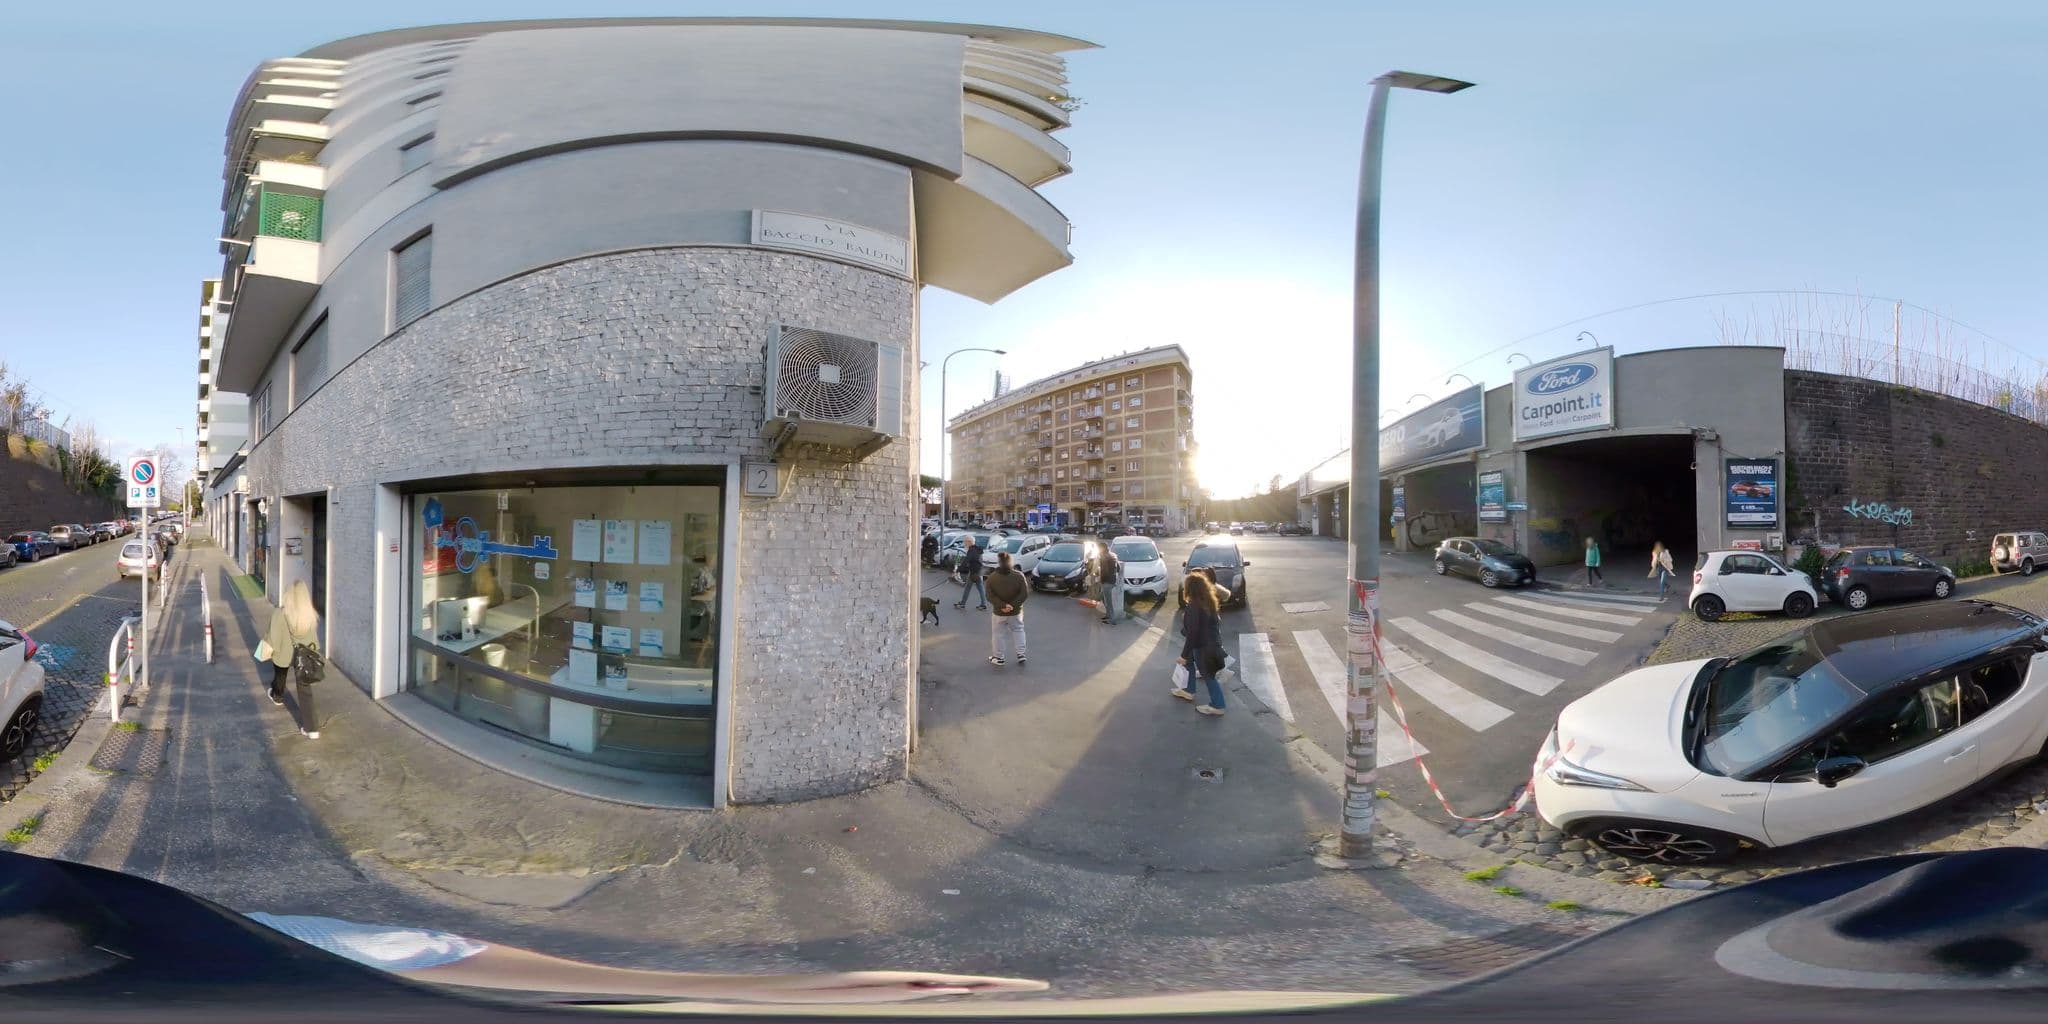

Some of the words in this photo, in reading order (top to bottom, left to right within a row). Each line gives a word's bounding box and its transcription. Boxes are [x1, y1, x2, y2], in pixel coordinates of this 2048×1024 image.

[825, 223, 856, 238] VIA
[763, 229, 834, 246] BACCIO
[846, 242, 904, 266] BALDINI
[1538, 367, 1581, 391] Ford
[1521, 392, 1602, 421] Carpoint.it
[758, 469, 768, 489] 2
